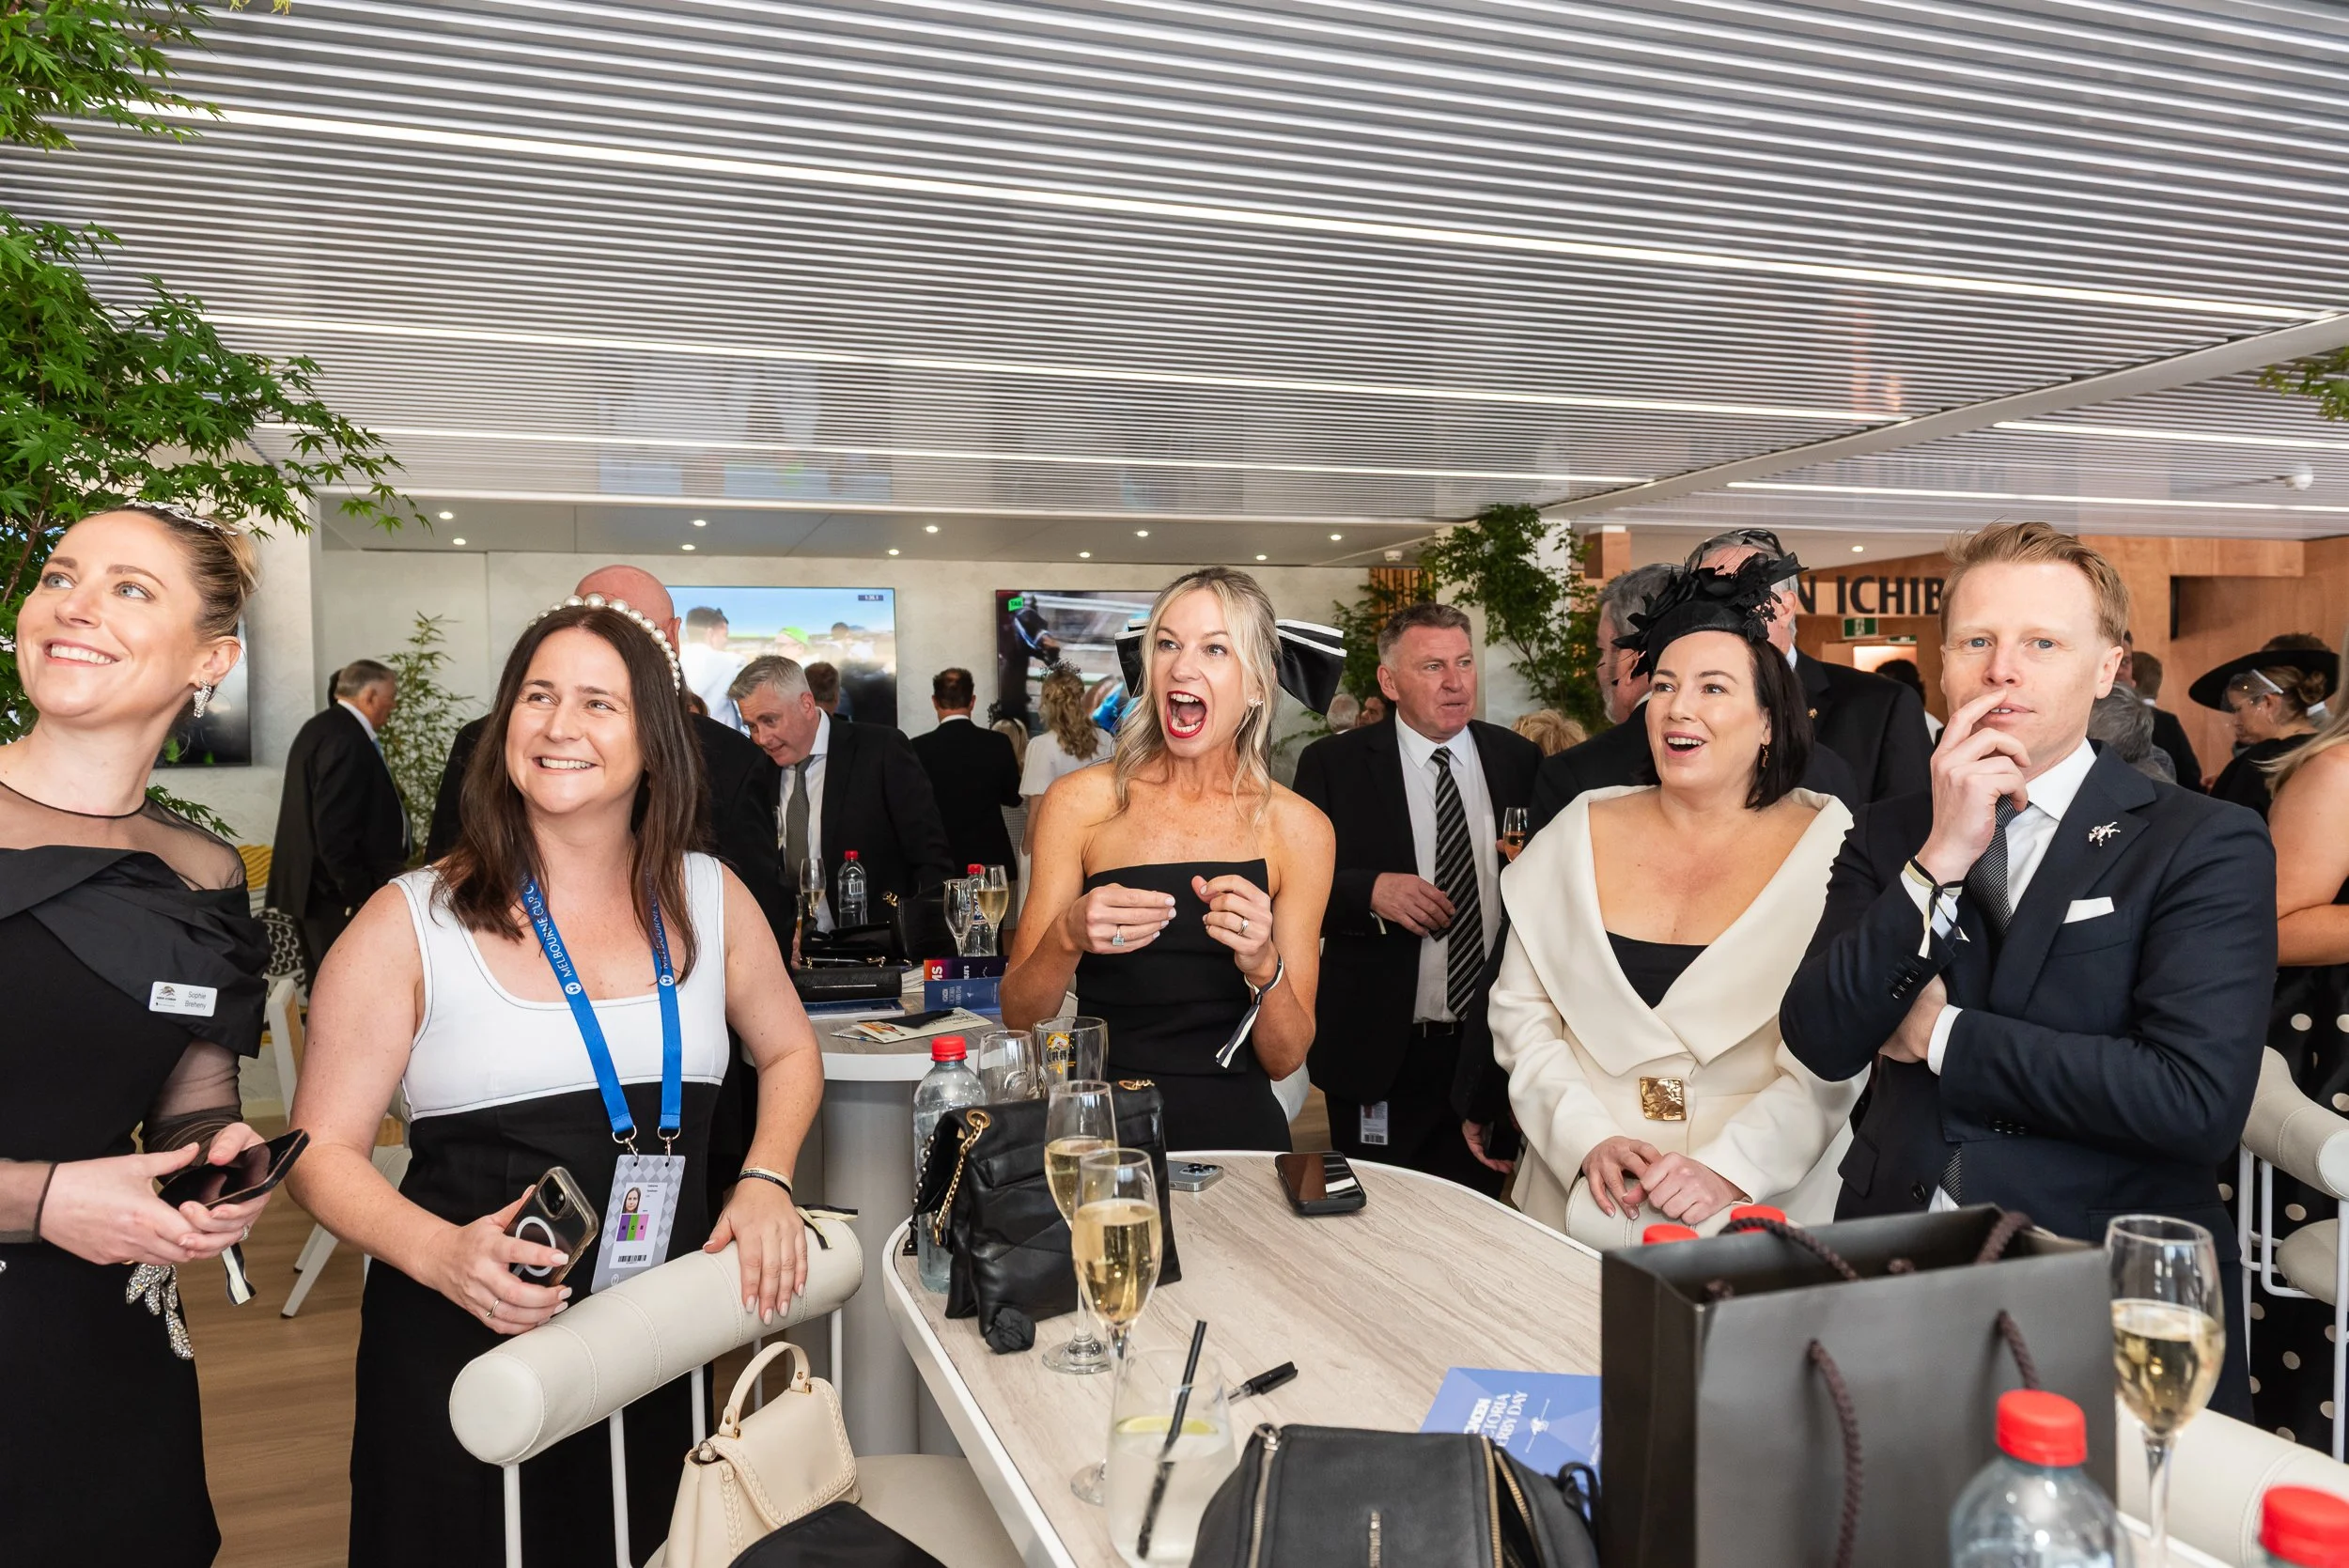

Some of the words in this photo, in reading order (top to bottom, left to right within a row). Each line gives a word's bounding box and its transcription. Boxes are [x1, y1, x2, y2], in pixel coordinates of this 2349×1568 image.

[1797, 576, 1816, 614] N
[1837, 575, 1944, 615] ICHIB
[527, 895, 544, 916] CUP
[537, 916, 572, 978] MELBOURNE
[188, 990, 207, 1000] Sophie
[1481, 1393, 1511, 1436] CTORIA
[1496, 1416, 1517, 1447] ERBY
[1507, 1390, 1529, 1416] DAY
